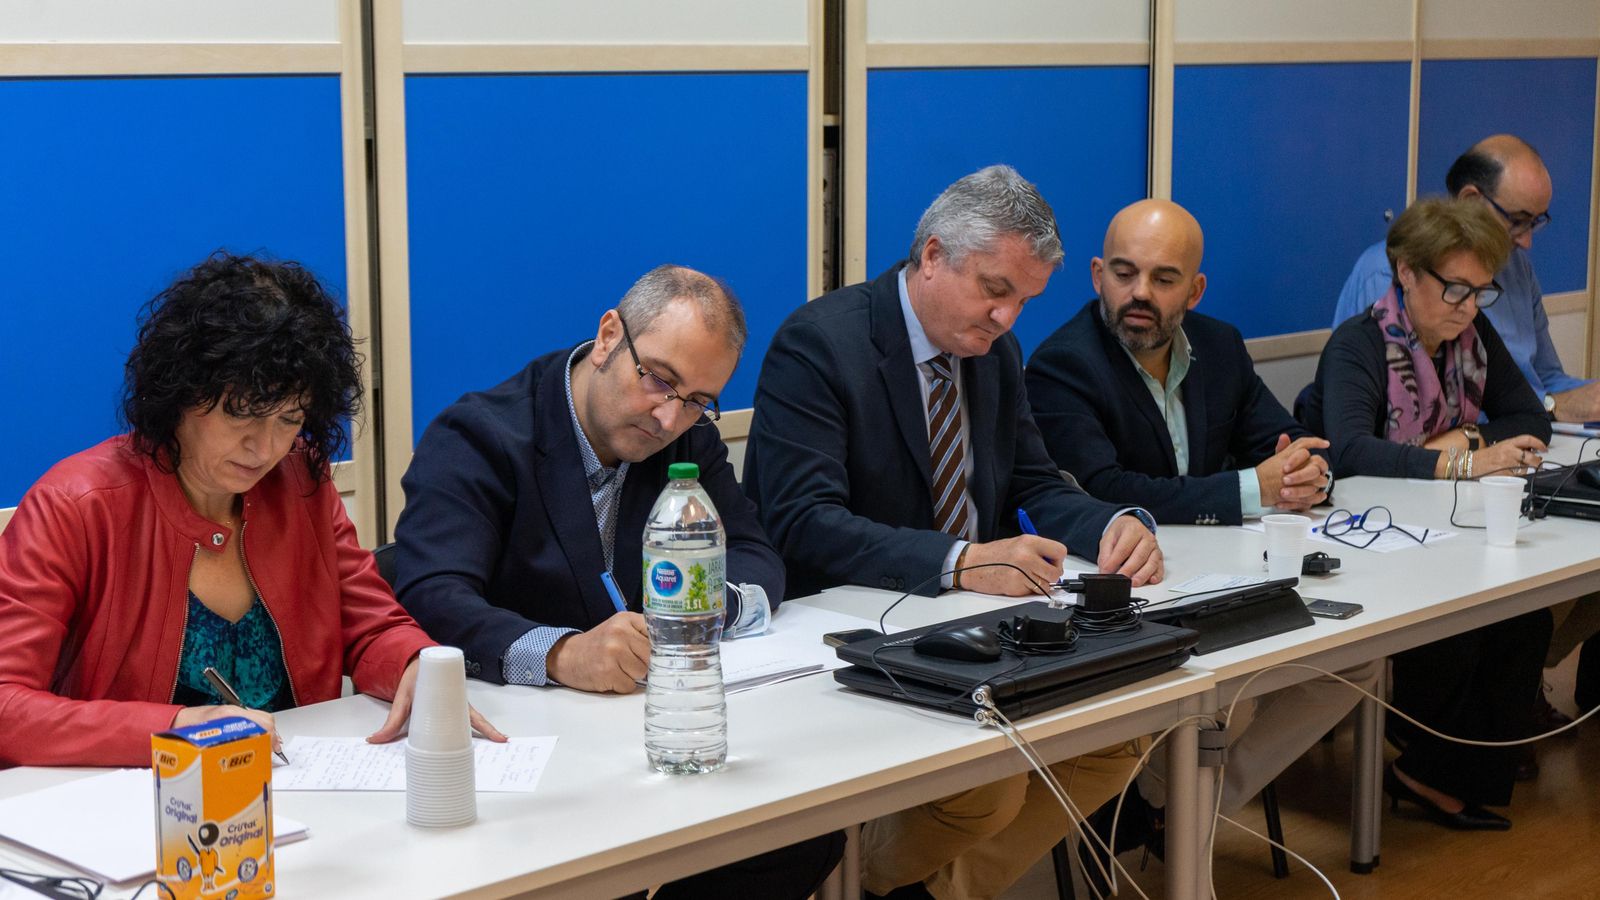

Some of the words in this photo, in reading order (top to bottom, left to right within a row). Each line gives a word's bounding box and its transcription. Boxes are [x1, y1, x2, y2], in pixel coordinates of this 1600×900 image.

[170, 796, 192, 811] Cristal
[165, 805, 198, 824] Original
[227, 820, 257, 834] Cristal
[219, 826, 264, 848] Original
